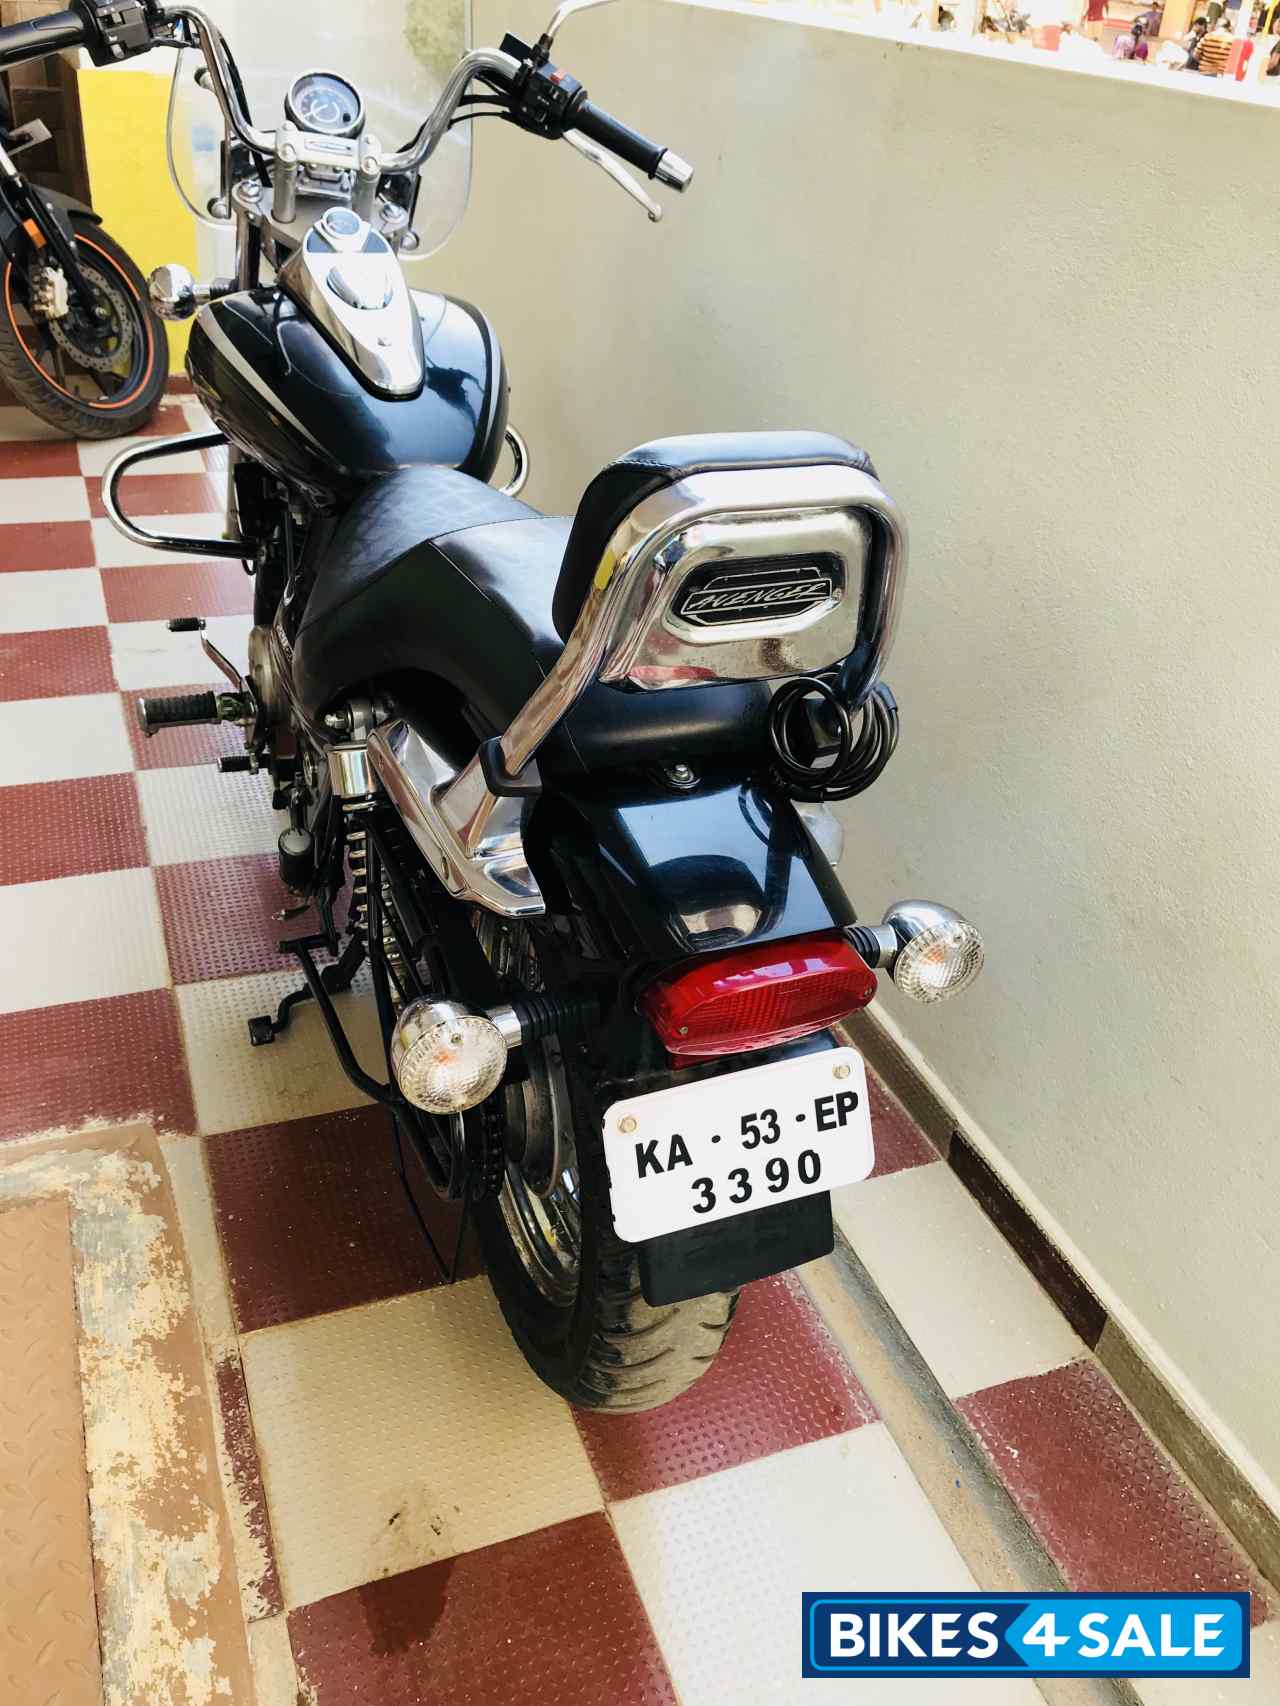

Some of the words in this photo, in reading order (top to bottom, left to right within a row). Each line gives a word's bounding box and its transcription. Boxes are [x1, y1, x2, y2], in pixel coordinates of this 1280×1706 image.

[688, 582, 828, 610] AVENGER
[635, 1133, 693, 1179] KA
[741, 1108, 781, 1150] 53
[814, 1090, 859, 1132] EP
[691, 1149, 822, 1214] 3390
